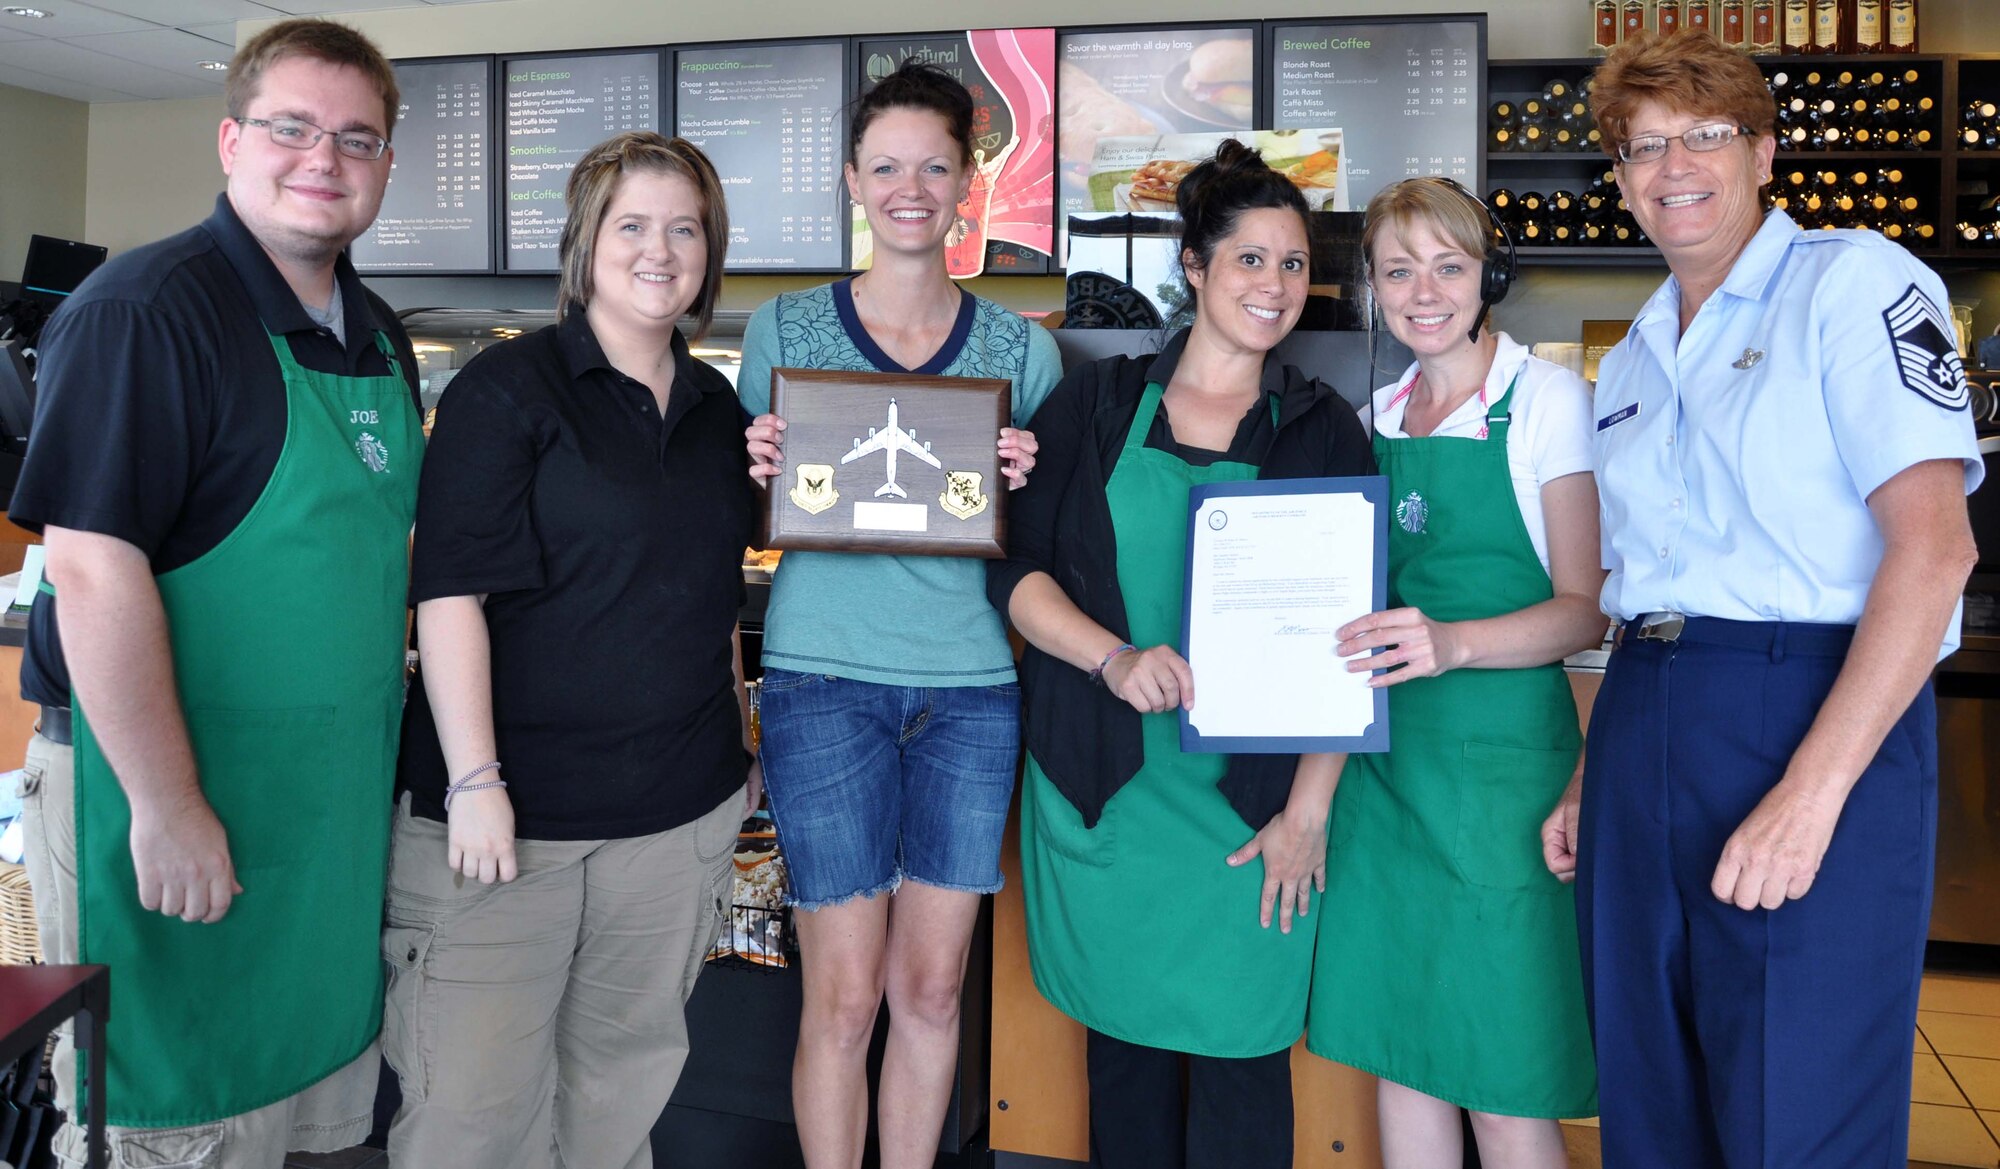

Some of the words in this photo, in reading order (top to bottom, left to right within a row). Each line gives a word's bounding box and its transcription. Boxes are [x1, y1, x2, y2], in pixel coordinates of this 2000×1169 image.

[1067, 43, 1090, 52] Savor
[1092, 43, 1106, 52] the
[1108, 42, 1141, 51] warmth
[1143, 41, 1153, 50] all
[1154, 40, 1170, 51] day
[1172, 40, 1194, 51] long.
[1283, 39, 1327, 50] Brewed
[1331, 38, 1371, 49] Coffee
[900, 44, 958, 64] Natural
[681, 60, 740, 74] Frappuccino
[1283, 61, 1308, 69] Blonde
[510, 72, 528, 82] Iced
[530, 72, 570, 83] Espresso
[565, 96, 594, 104] Macchiato
[724, 118, 750, 126] Crumble
[510, 145, 557, 156] Smoothies
[510, 163, 541, 171] Strawberry,
[510, 191, 530, 200] Iced
[532, 189, 563, 200] Coffee
[734, 236, 749, 244] Chip
[350, 410, 379, 424] JOE
